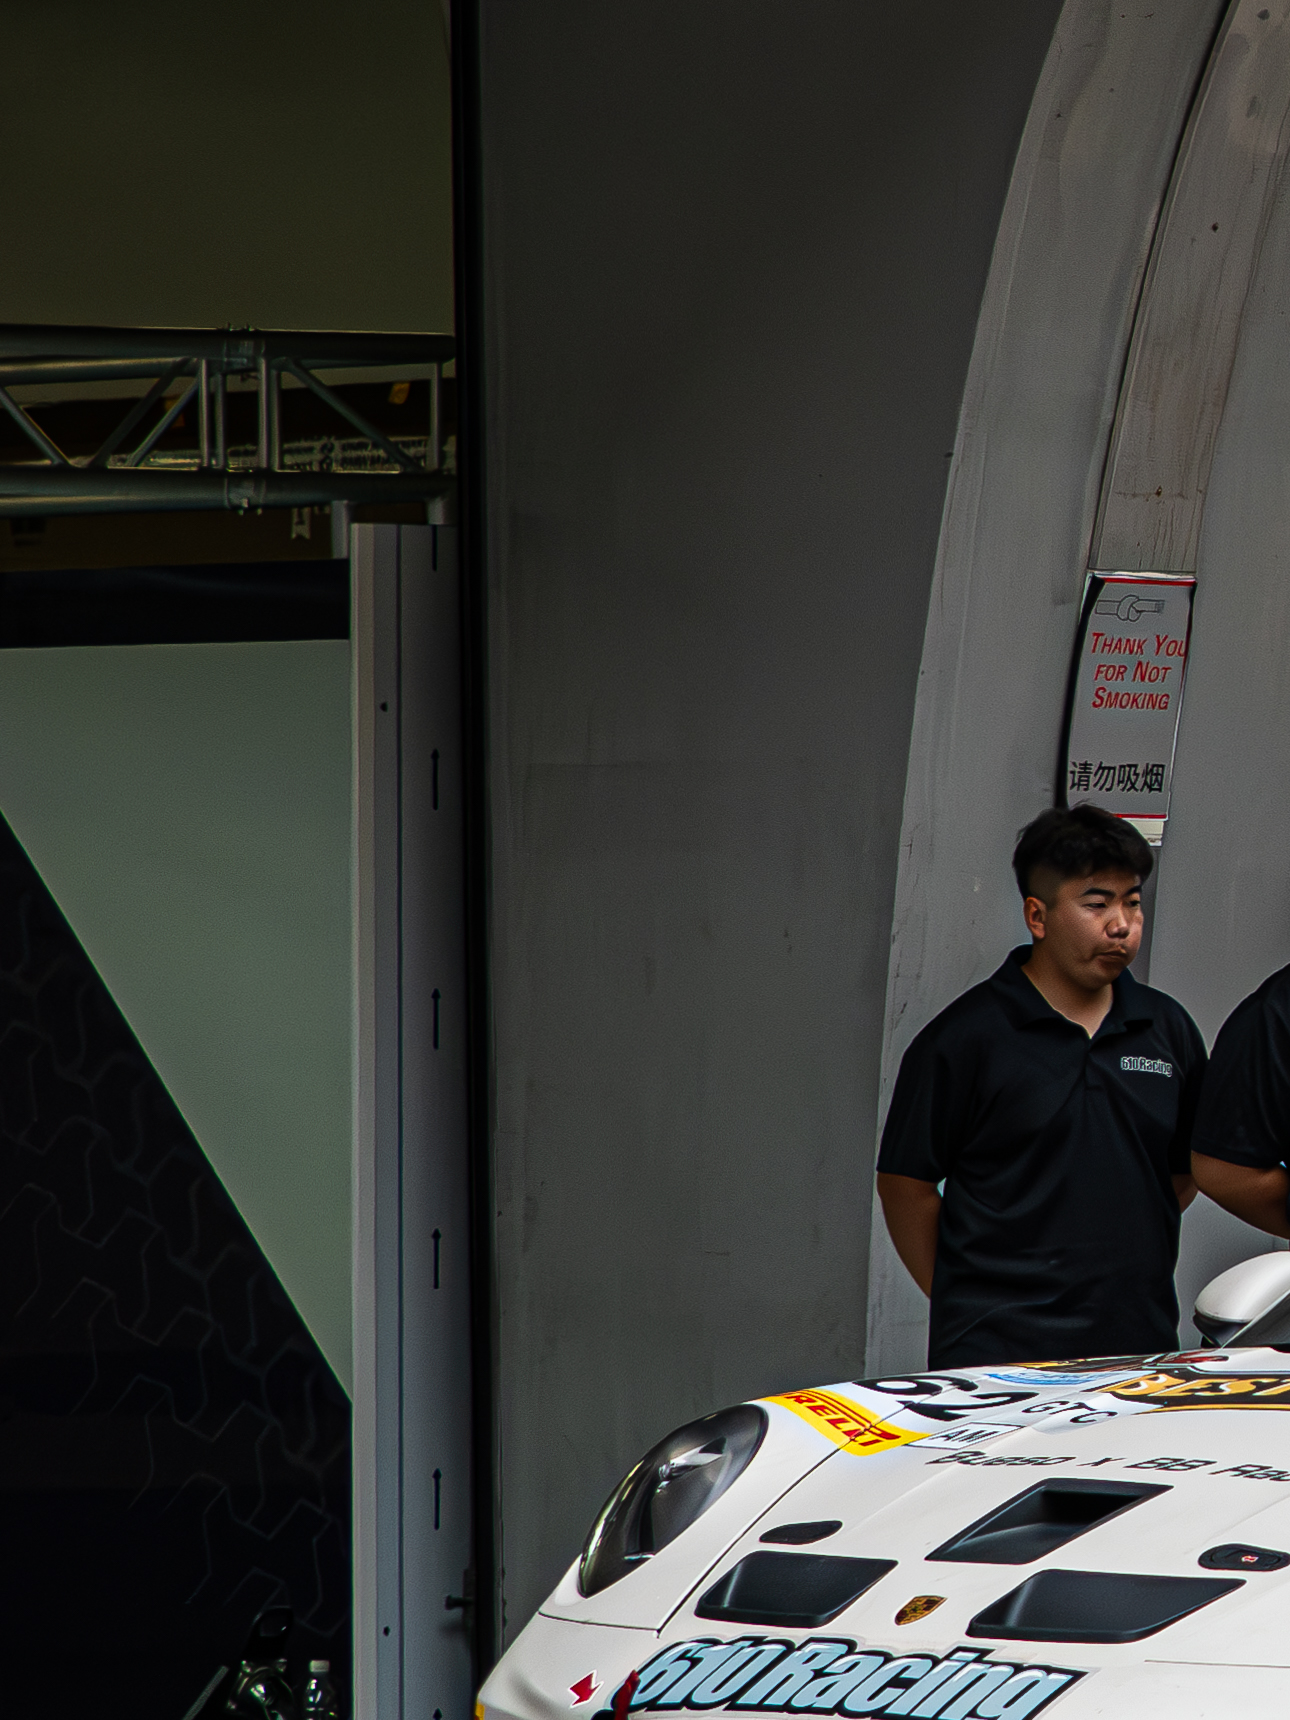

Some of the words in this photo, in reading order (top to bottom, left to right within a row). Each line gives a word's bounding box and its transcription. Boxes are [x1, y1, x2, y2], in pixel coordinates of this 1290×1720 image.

[1069, 761, 1165, 793] 请勿吸烟
[930, 1427, 999, 1443] AM
[1126, 1457, 1217, 1472] BB
